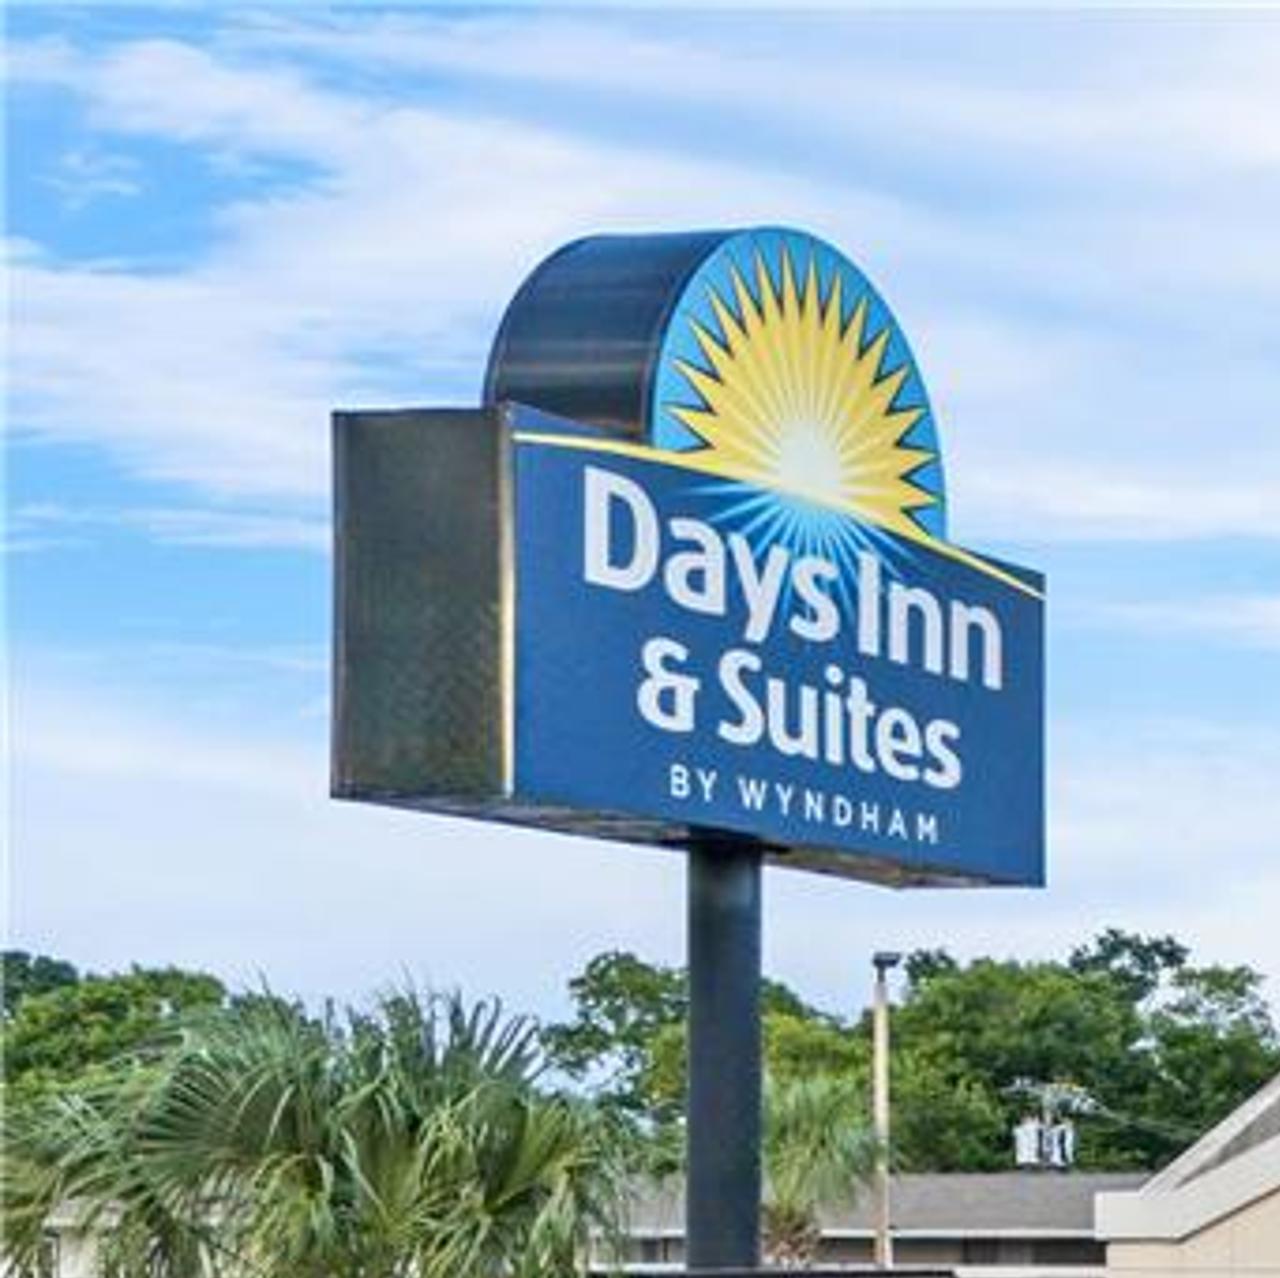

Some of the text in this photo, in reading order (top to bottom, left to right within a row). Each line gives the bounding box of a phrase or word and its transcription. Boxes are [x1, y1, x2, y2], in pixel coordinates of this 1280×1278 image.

[584, 465, 1003, 691] Days Inn
[636, 637, 963, 791] & Suites
[669, 764, 939, 845] BY WYNDHAM
